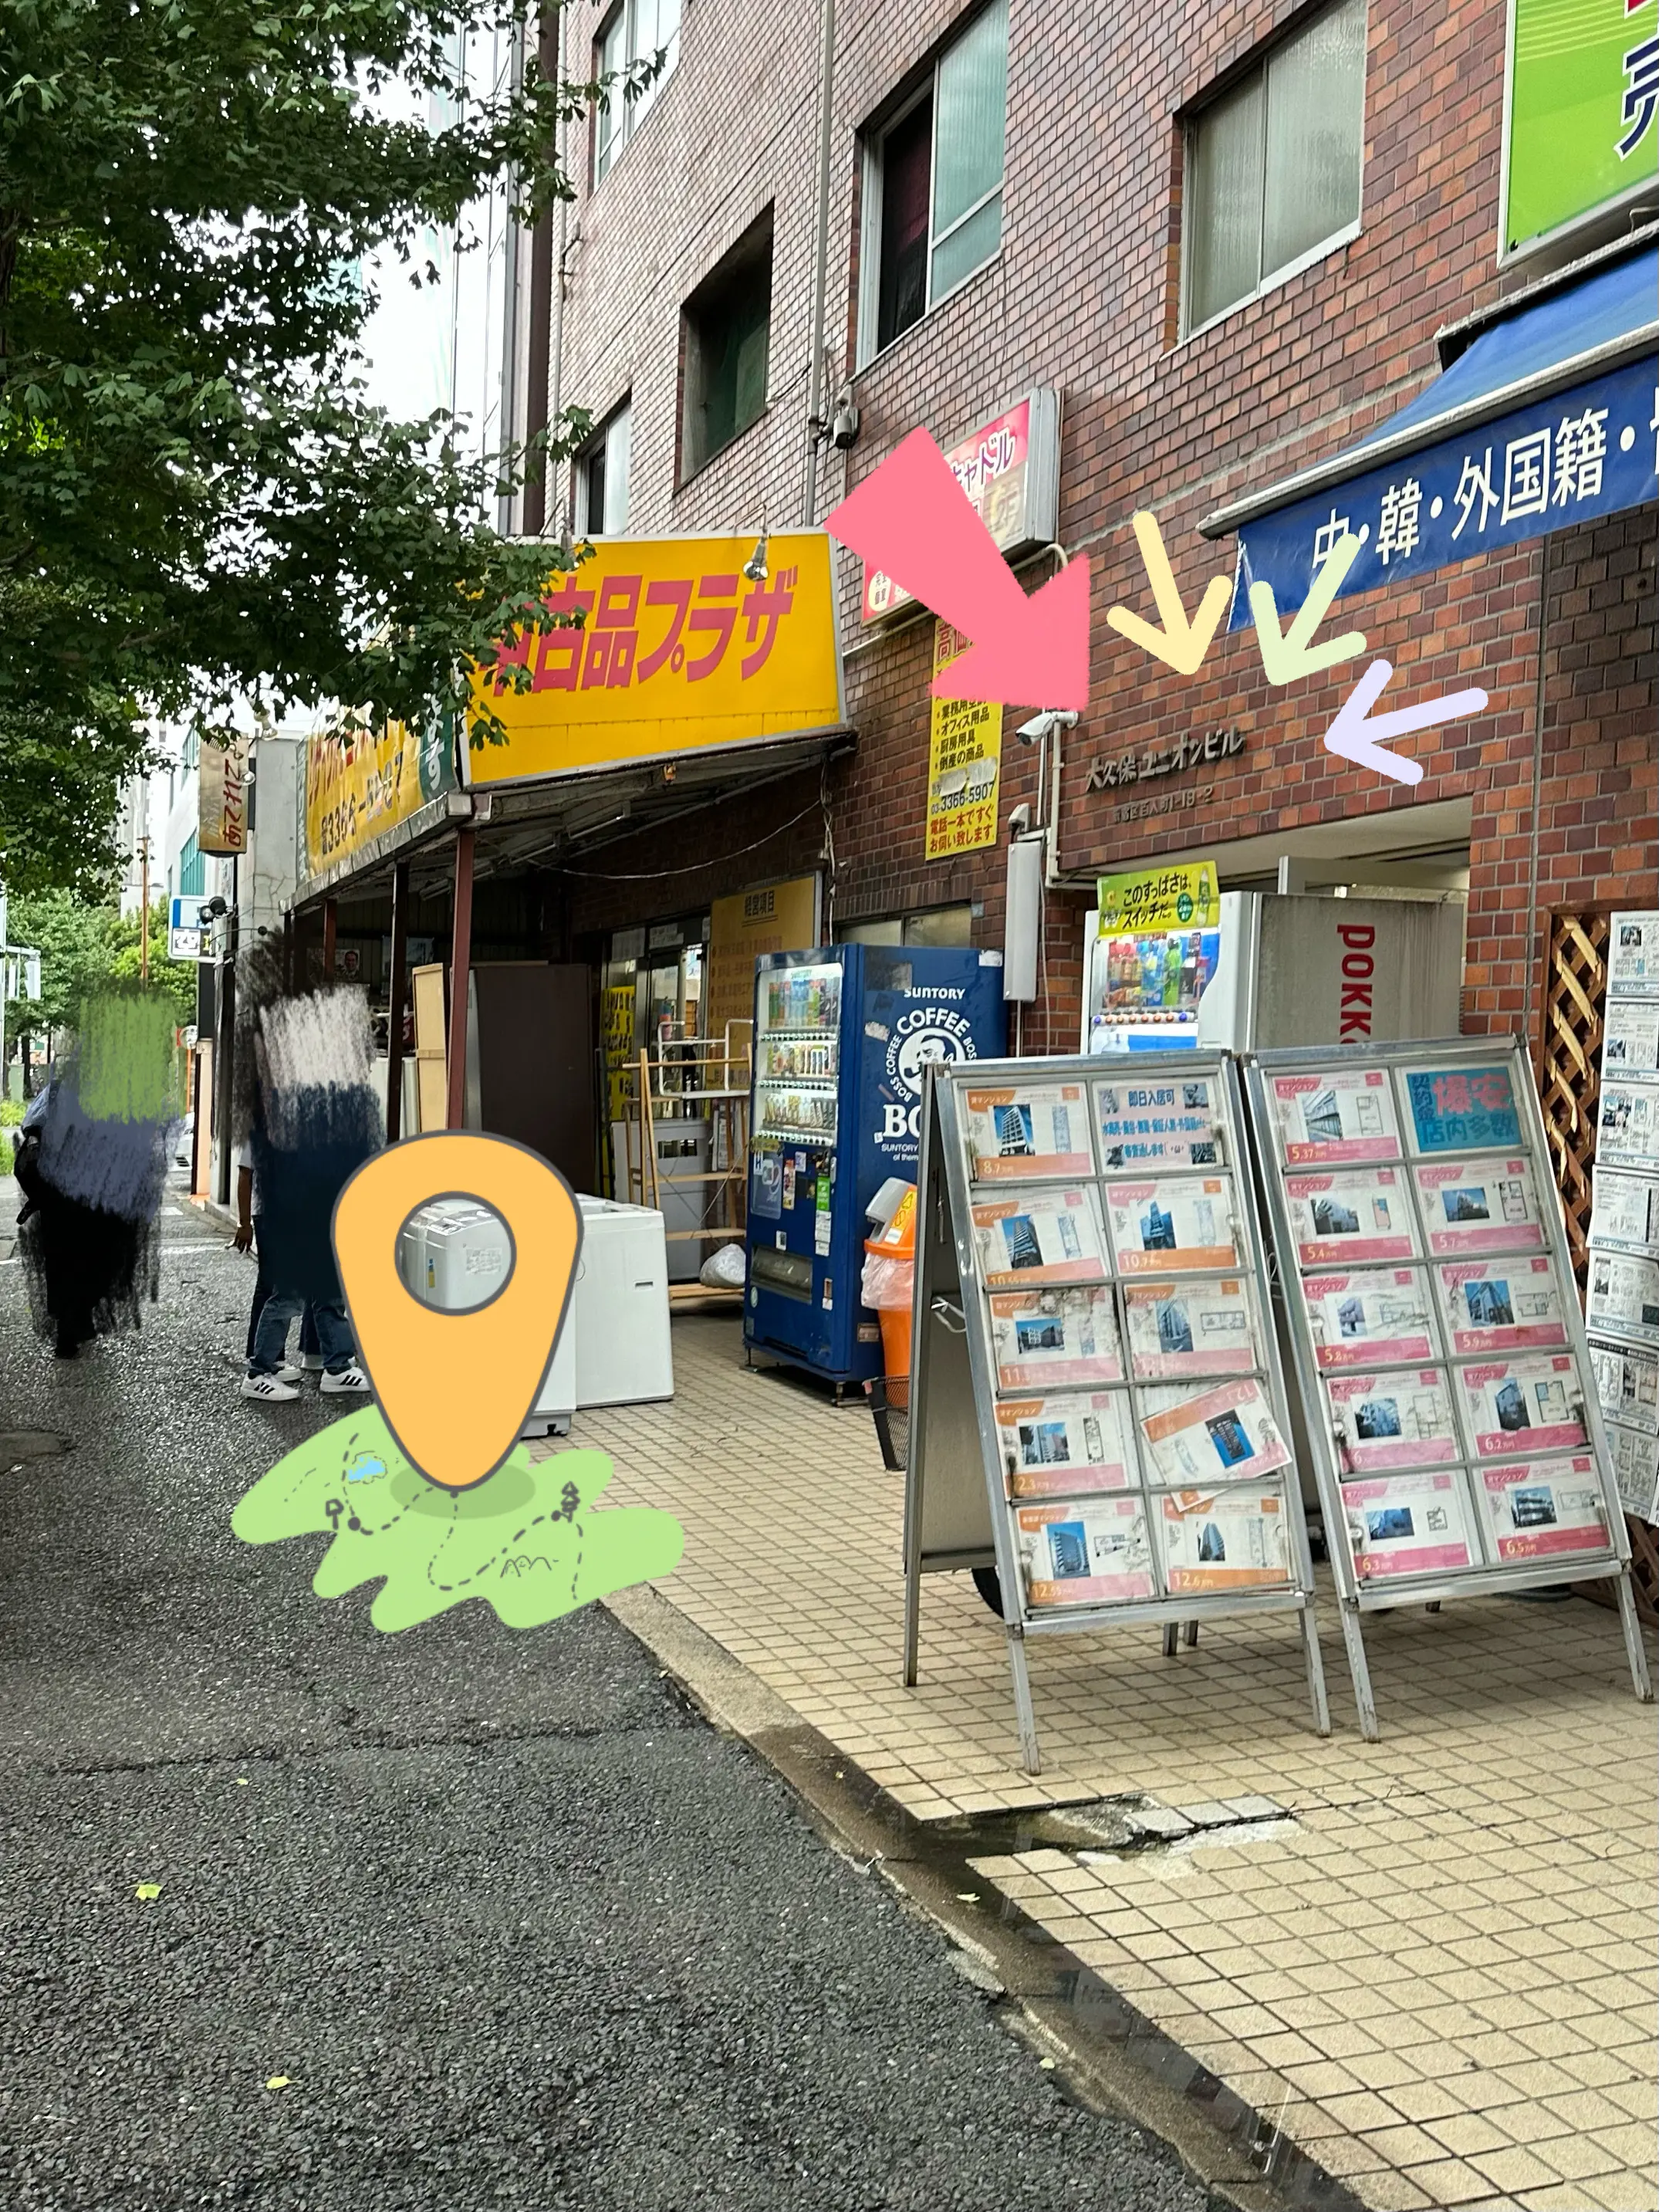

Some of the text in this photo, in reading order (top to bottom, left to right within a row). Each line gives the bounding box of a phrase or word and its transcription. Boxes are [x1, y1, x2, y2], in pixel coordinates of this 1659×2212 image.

[1313, 387, 1658, 569] 中・韓・外国籍・
[931, 782, 995, 815] 03-3366-5907
[930, 803, 995, 835] 電話一本ですぐ
[930, 824, 993, 853] お伺い致します
[1123, 871, 1192, 908] このすっぱさは、
[1122, 900, 1172, 931] スイッチだ。
[896, 1006, 971, 1037] COFFEE
[885, 1033, 914, 1104] BOSS COFFEE
[1128, 1088, 1175, 1108] 即日入居可
